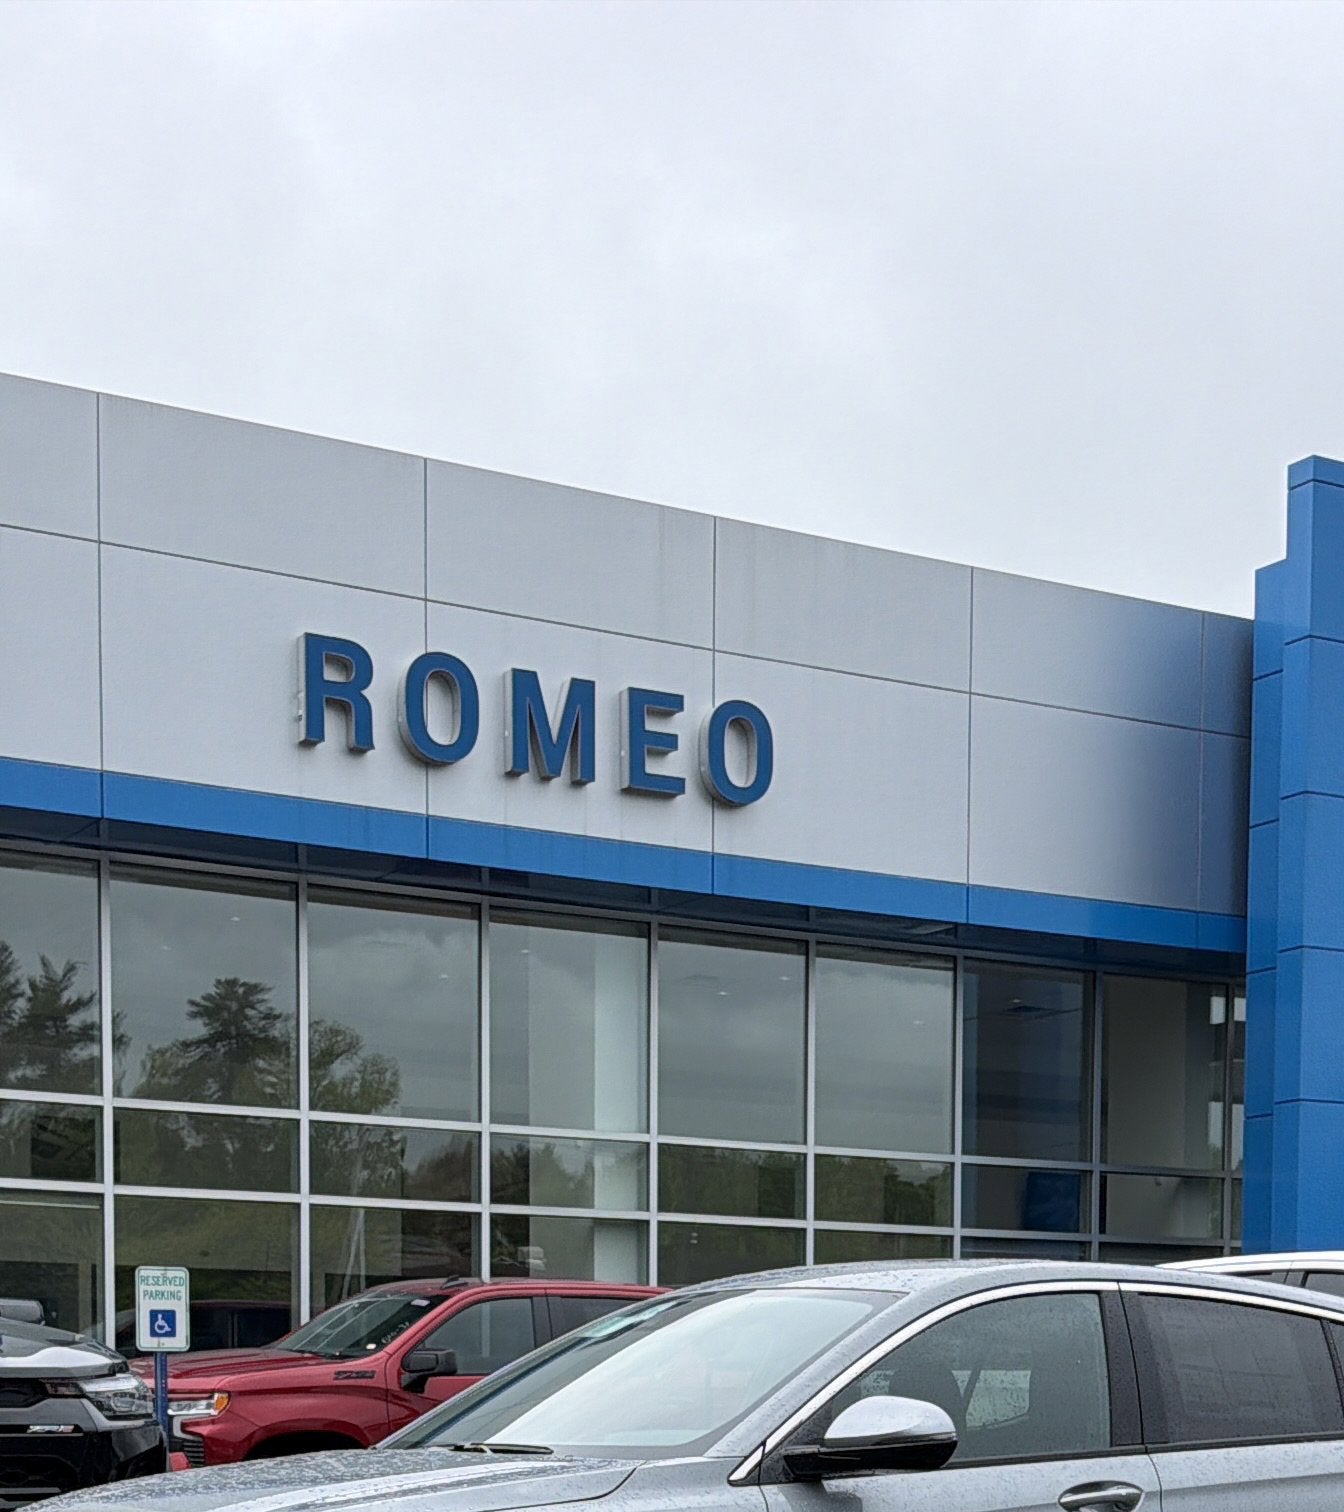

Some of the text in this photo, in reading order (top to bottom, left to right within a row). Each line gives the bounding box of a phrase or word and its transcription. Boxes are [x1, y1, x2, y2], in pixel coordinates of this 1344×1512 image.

[298, 632, 774, 806] ROMEO
[140, 1275, 185, 1287] RESERVED
[143, 1289, 182, 1301] PARKING
